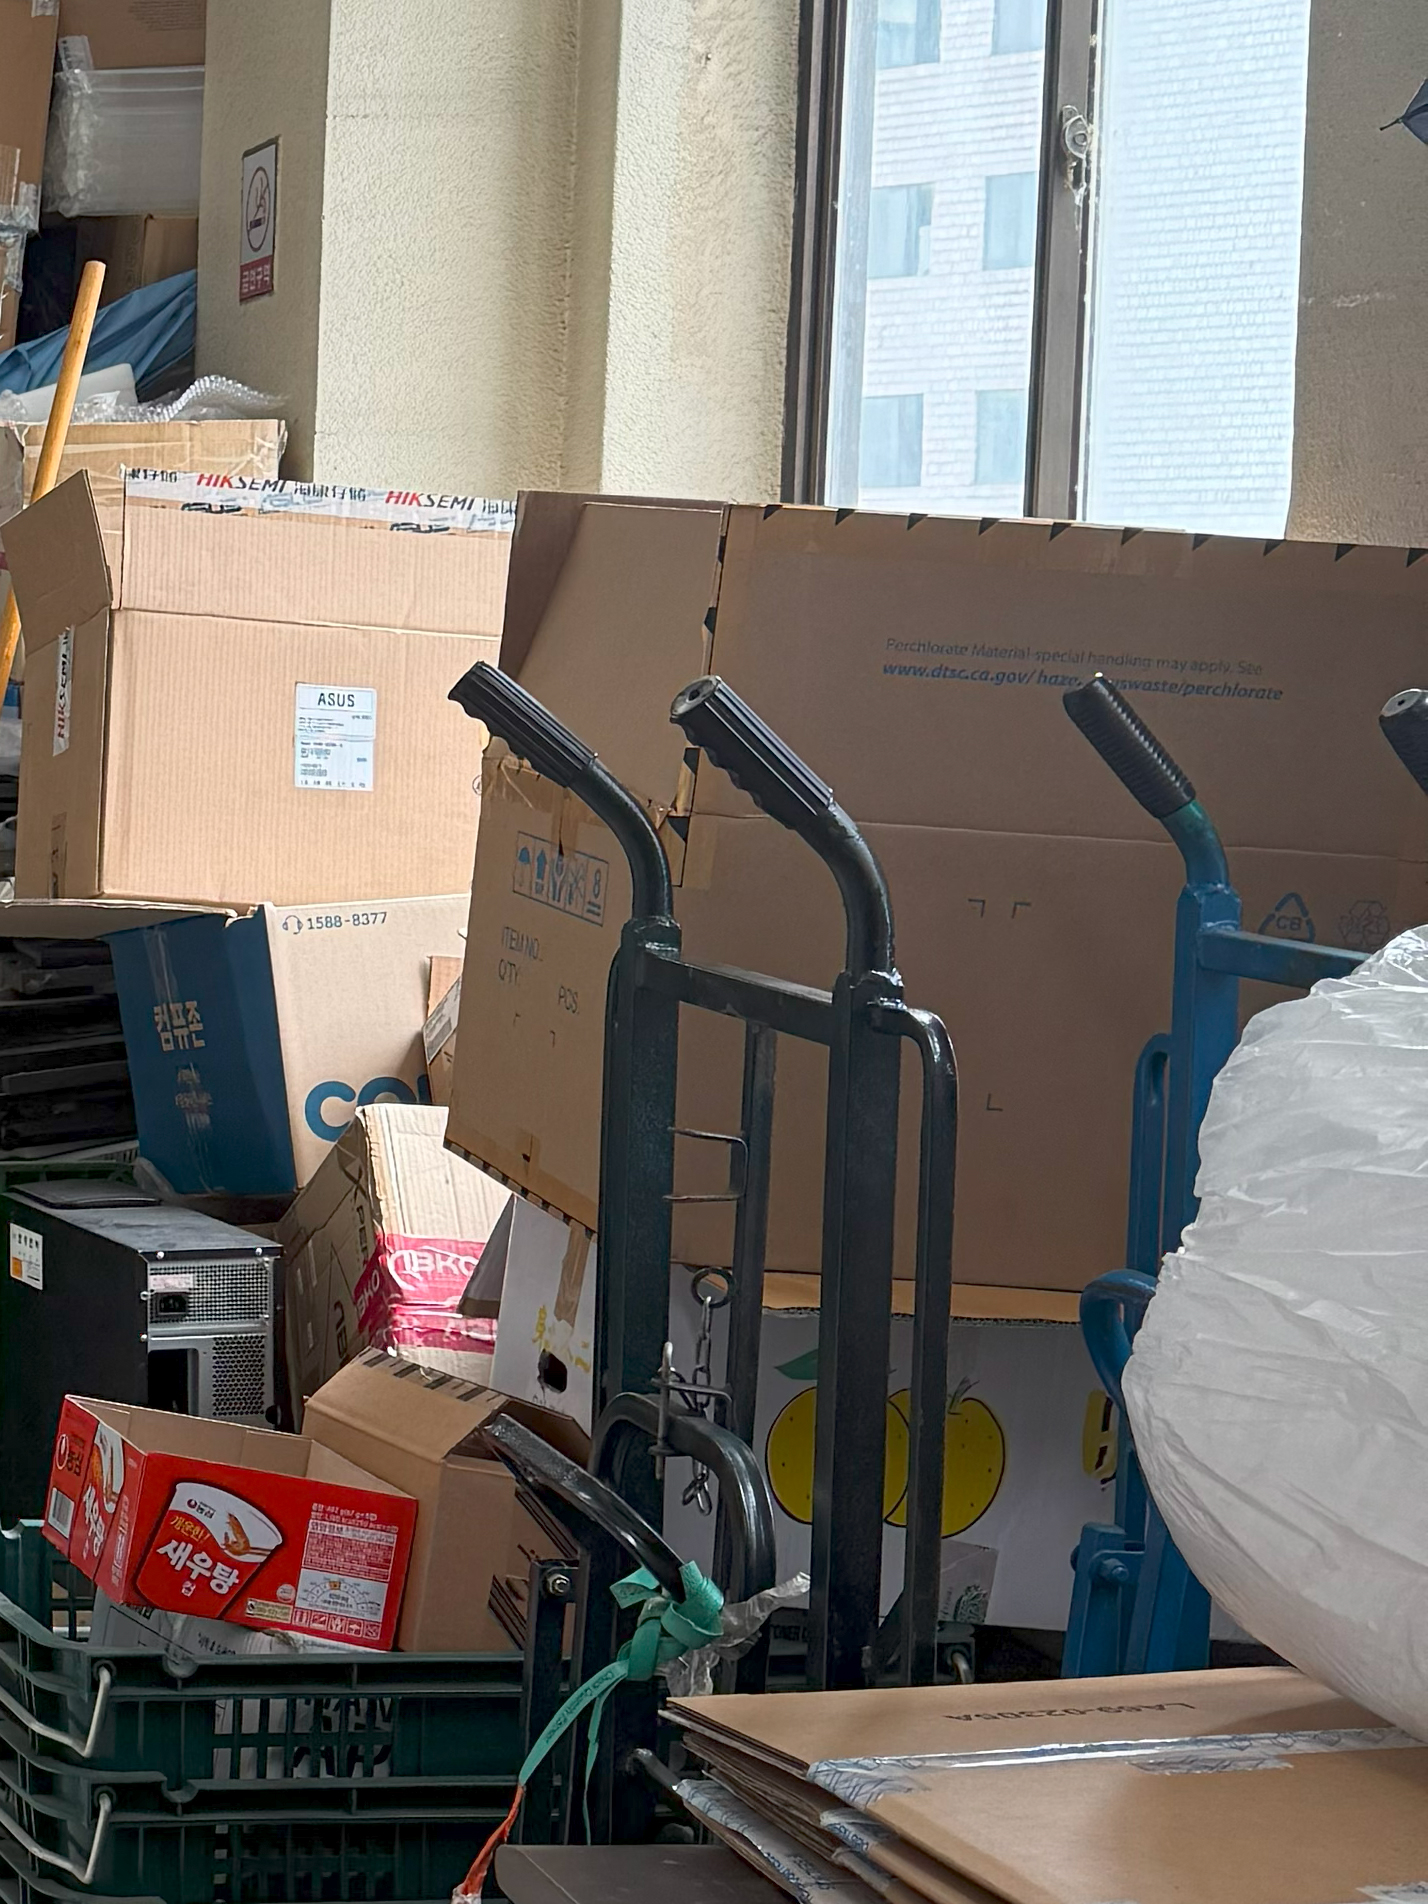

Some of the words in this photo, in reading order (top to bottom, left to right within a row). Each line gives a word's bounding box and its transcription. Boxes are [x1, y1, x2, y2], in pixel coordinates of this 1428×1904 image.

[196, 473, 286, 495] HIKSEMI
[384, 489, 477, 512] HIKSEMI
[885, 637, 969, 659] Perchlorate
[1087, 651, 1152, 673] handling
[1155, 656, 1187, 675] may
[317, 692, 356, 708] ASUS
[306, 910, 389, 932] 1588-8377
[153, 999, 206, 1052] 컴퓨존
[169, 1513, 212, 1544] 개운한!
[155, 1537, 241, 1596] 새우탕
